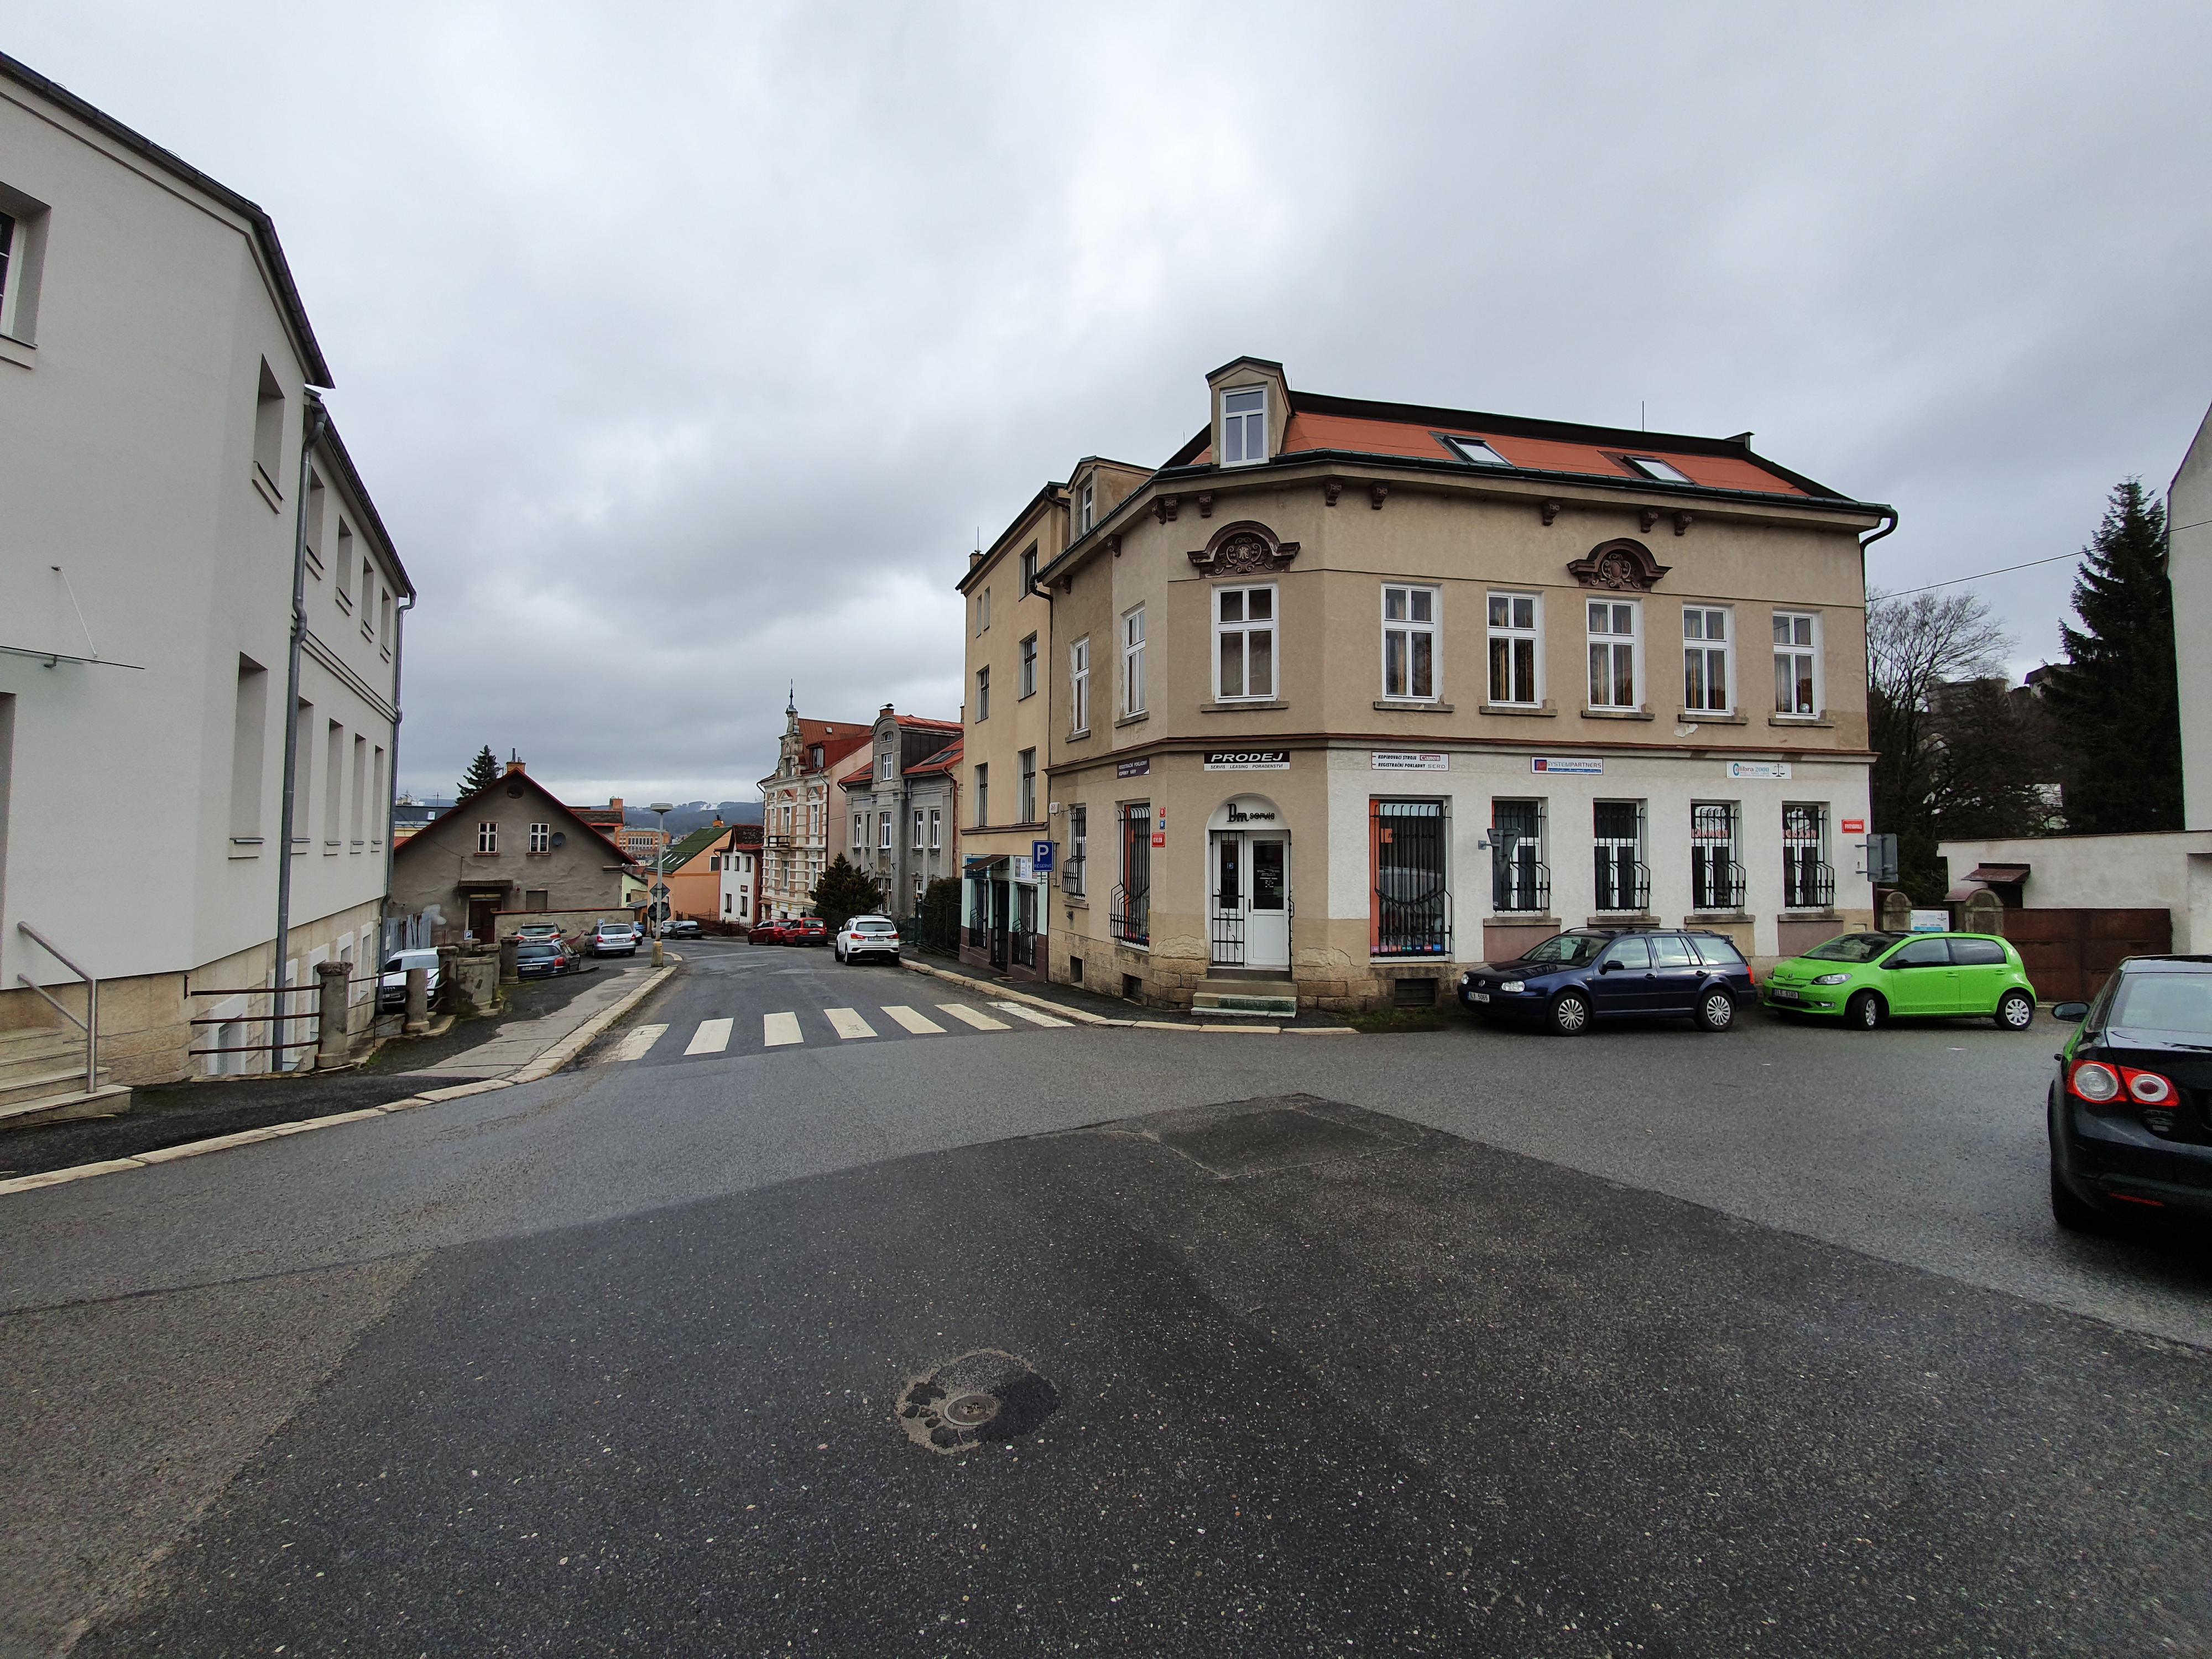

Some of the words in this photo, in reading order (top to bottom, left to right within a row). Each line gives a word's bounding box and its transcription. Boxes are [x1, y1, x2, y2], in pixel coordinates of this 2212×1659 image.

[1211, 753, 1284, 763] PRODEJ
[1733, 763, 1754, 776] Calibra
[1037, 844, 1049, 862] P
